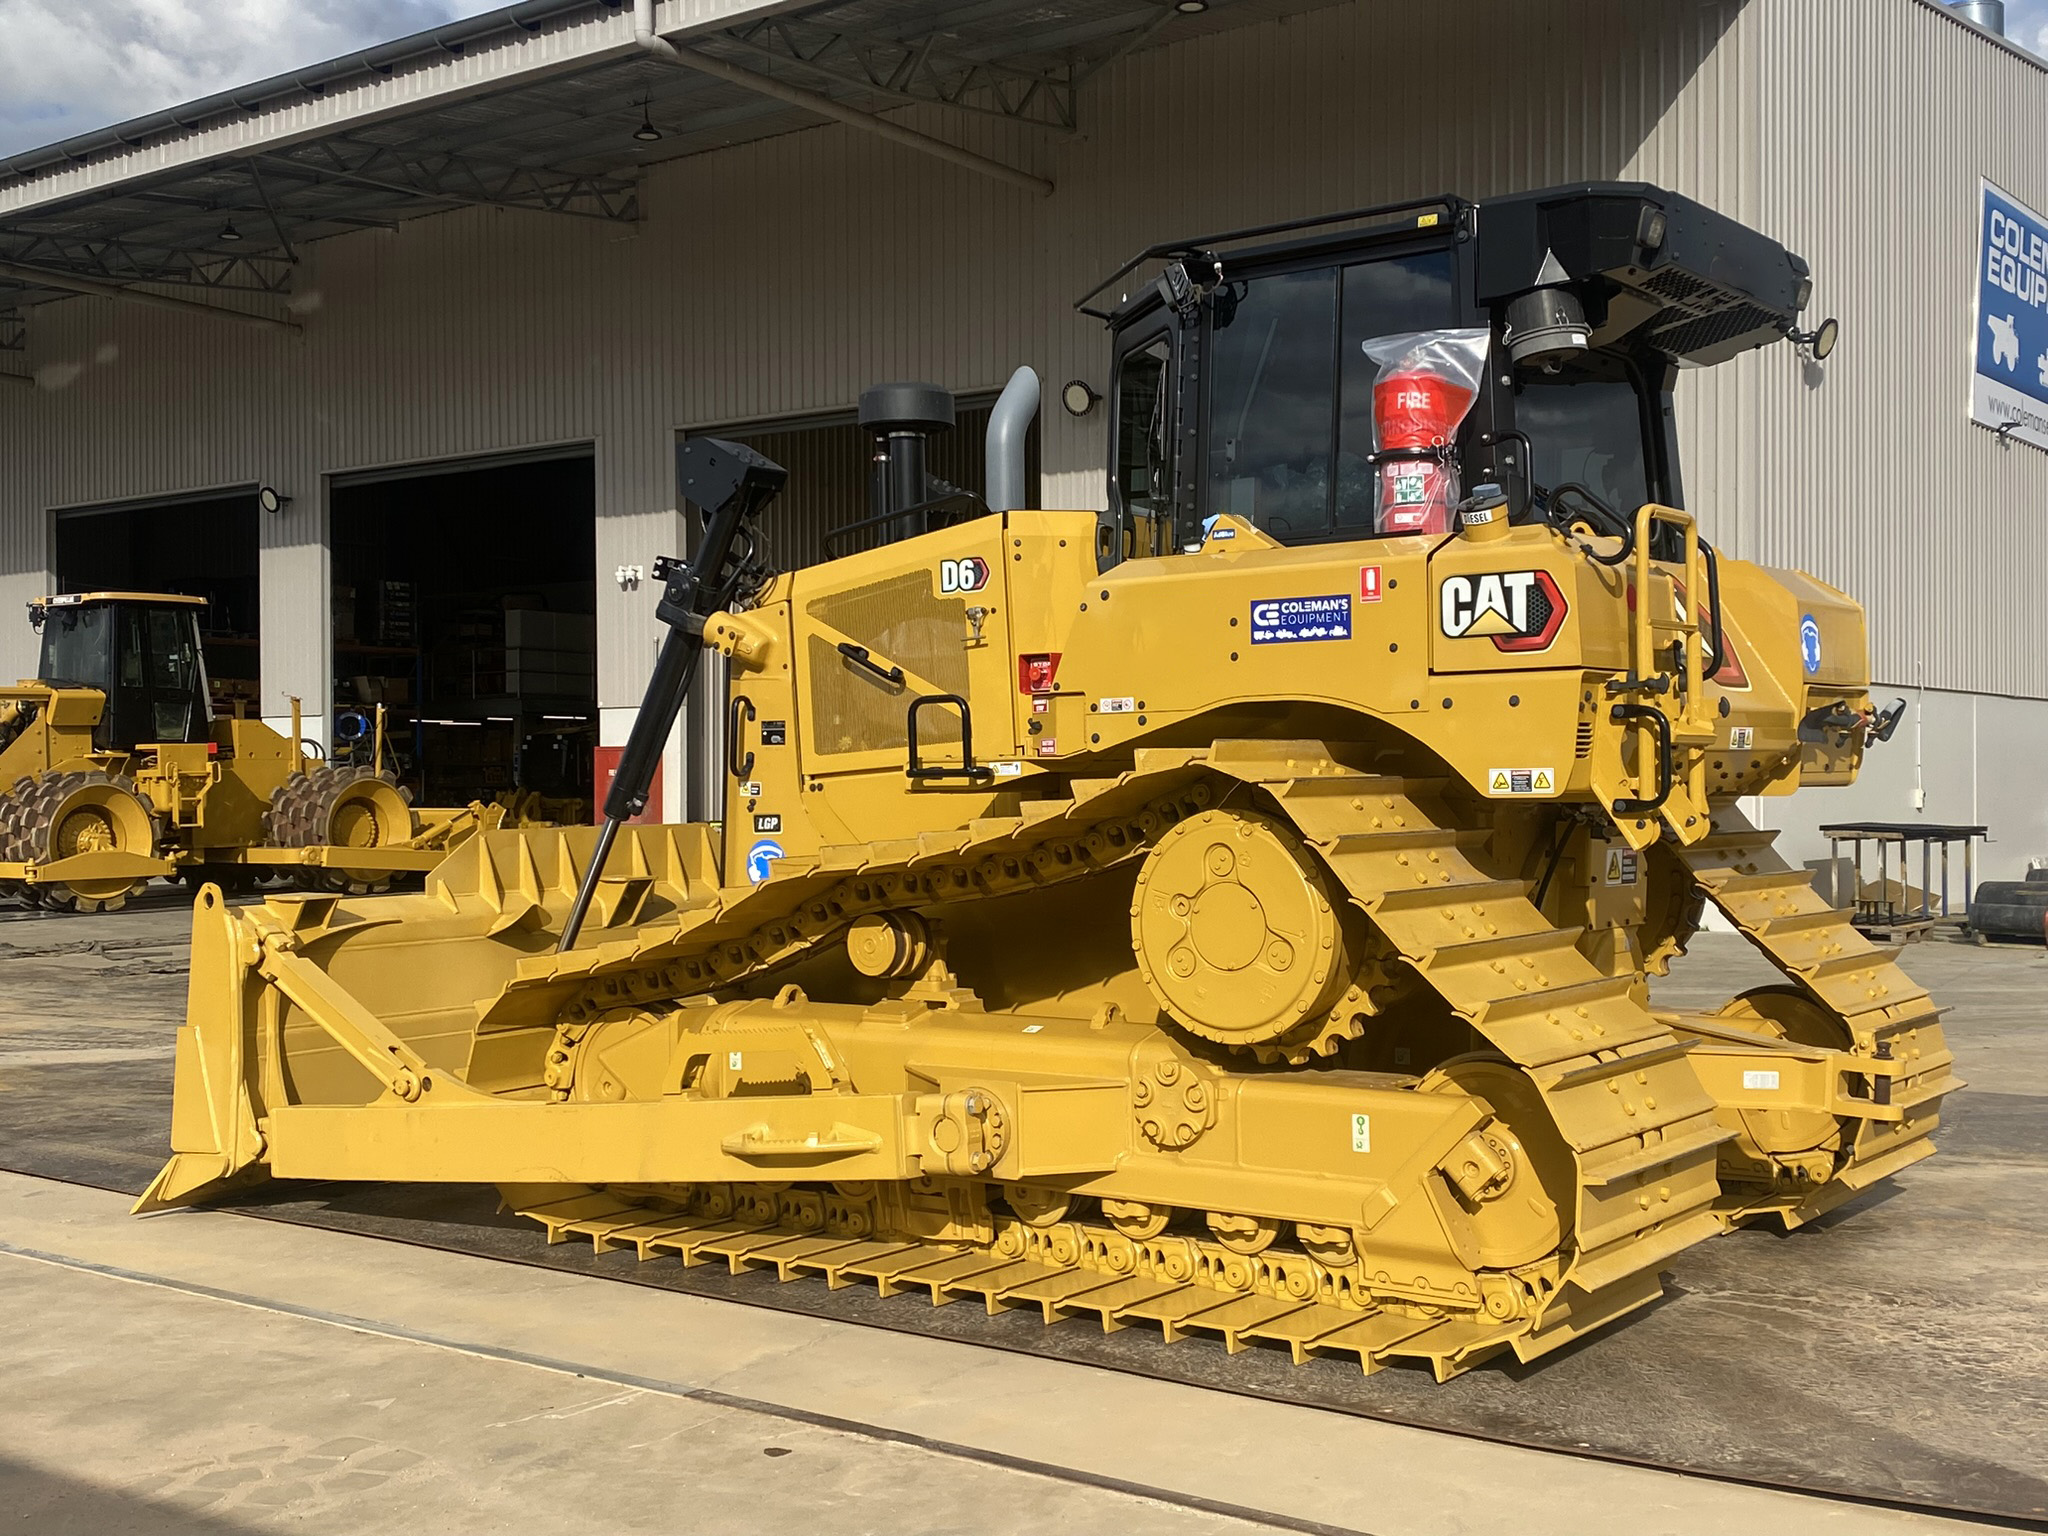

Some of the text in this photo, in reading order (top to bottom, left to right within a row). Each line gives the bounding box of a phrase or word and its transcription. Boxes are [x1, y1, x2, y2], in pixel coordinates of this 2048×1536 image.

[1987, 245, 2048, 310] EQUIP
[1397, 391, 1431, 409] FIRE
[1463, 512, 1488, 524] DIESEL
[941, 558, 976, 592] D6
[1281, 598, 1349, 614] COLEMAN'S
[1441, 572, 1535, 637] CAT
[1281, 611, 1348, 625] EQUIPMENT
[758, 817, 779, 830] LGP
